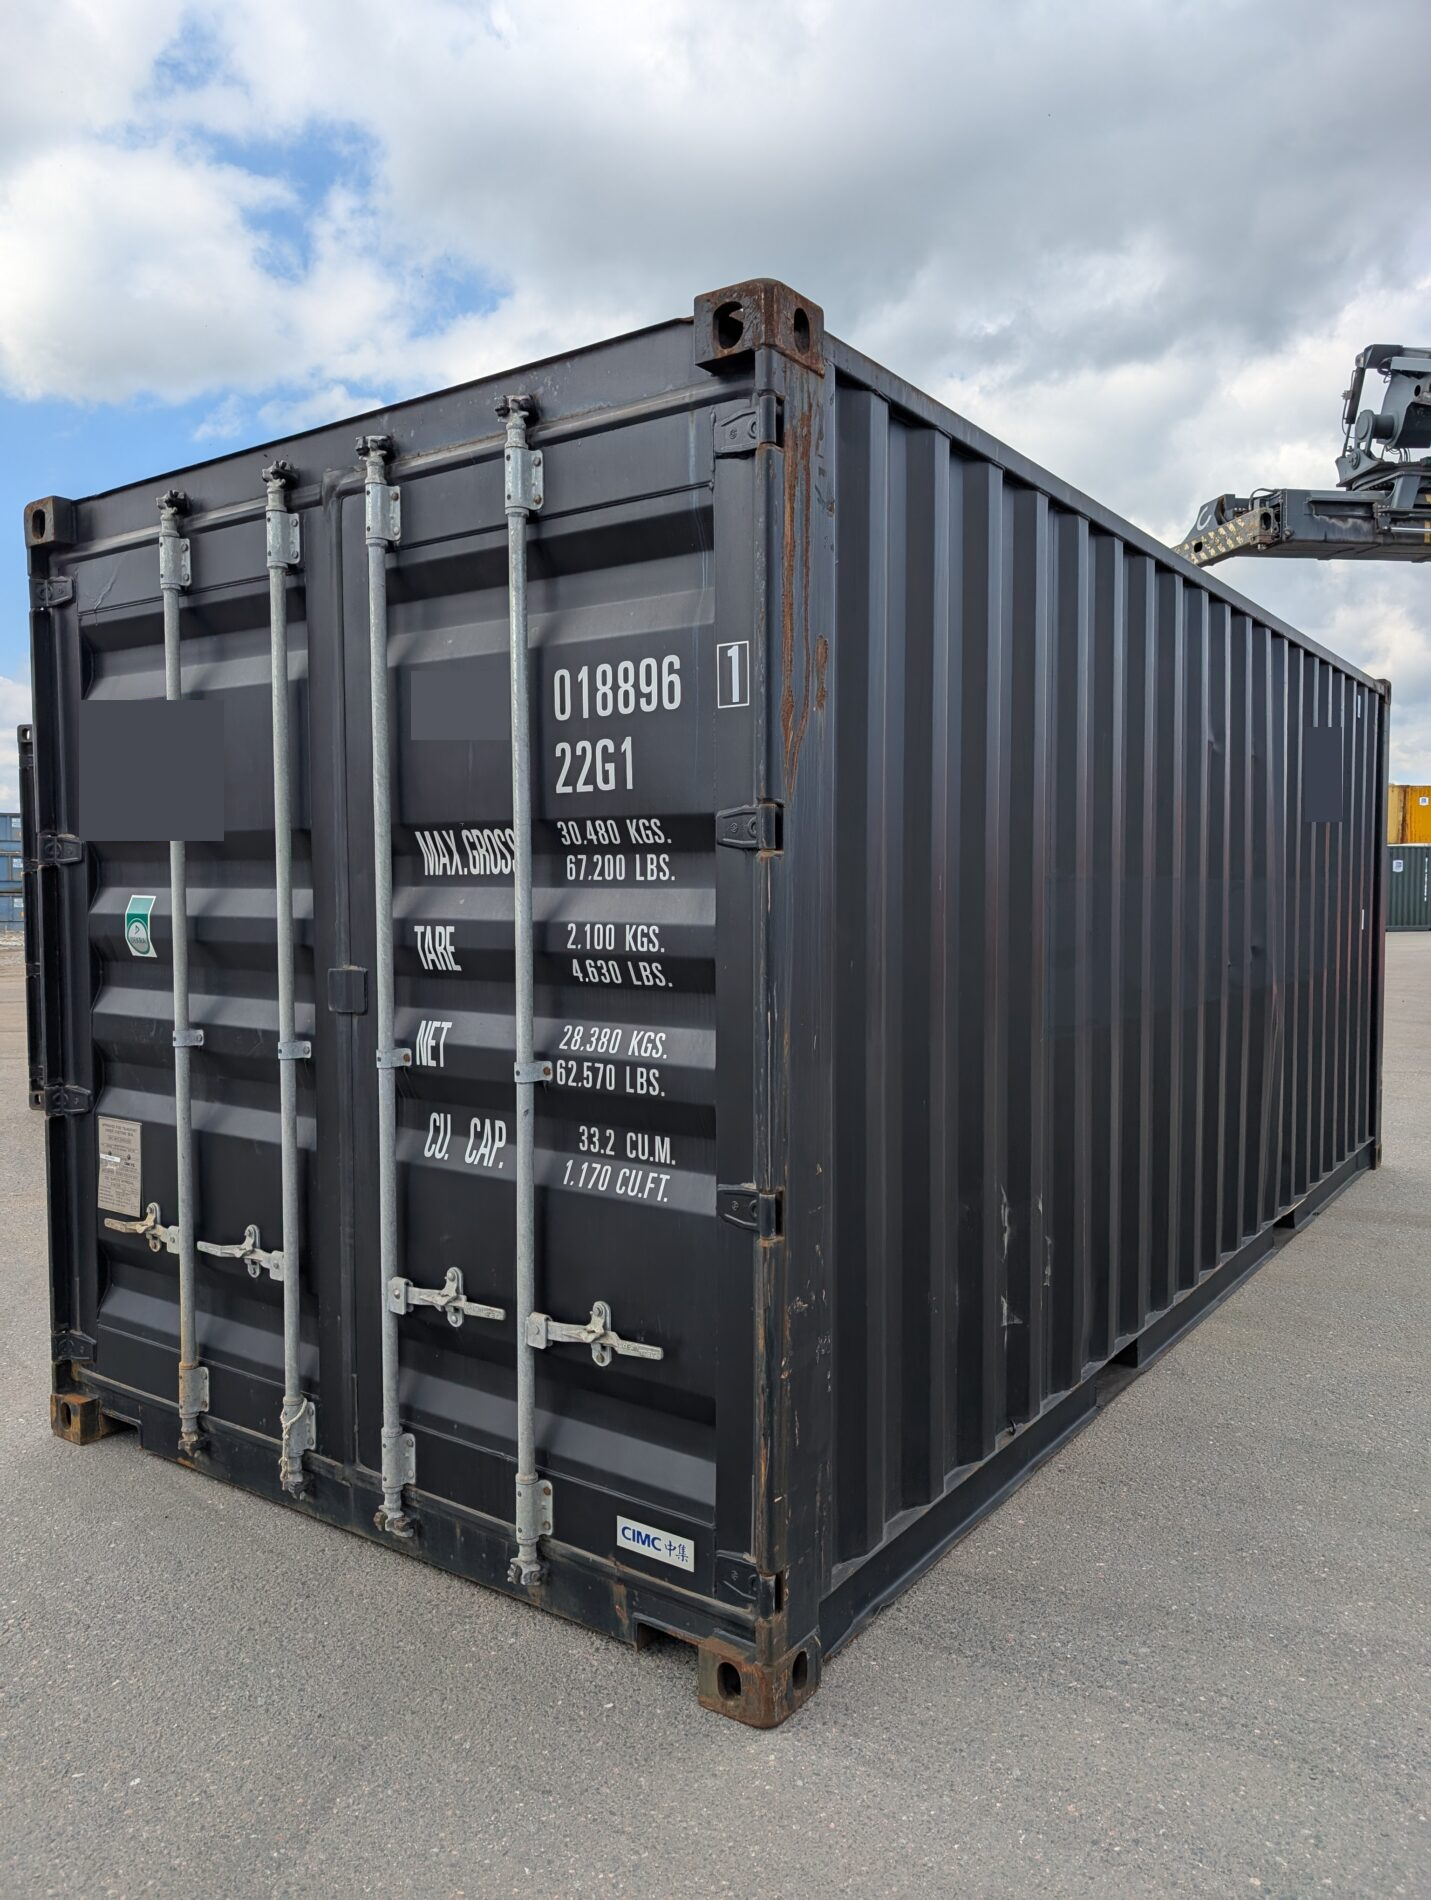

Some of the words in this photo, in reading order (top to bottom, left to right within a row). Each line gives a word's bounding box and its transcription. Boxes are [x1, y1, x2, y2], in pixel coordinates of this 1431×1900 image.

[553, 654, 682, 721] 018896
[727, 645, 740, 703] 1
[555, 736, 633, 794] 22G1
[625, 818, 672, 844] KGS.
[635, 853, 676, 881] LBS.
[413, 925, 462, 971] TARE
[625, 924, 665, 953] KGS.
[627, 961, 673, 988] LBS.
[415, 1020, 453, 1068] NET
[627, 1030, 668, 1059] KGS.
[625, 1065, 665, 1097] LBS.
[423, 1112, 451, 1161] CU.
[464, 1117, 507, 1169] CAP.
[579, 1125, 615, 1156] 33.2
[626, 1132, 676, 1166] CU.M.
[615, 1168, 671, 1203] CU.FT.
[621, 1526, 662, 1552] CIMC
[664, 1539, 689, 1563] 中集
